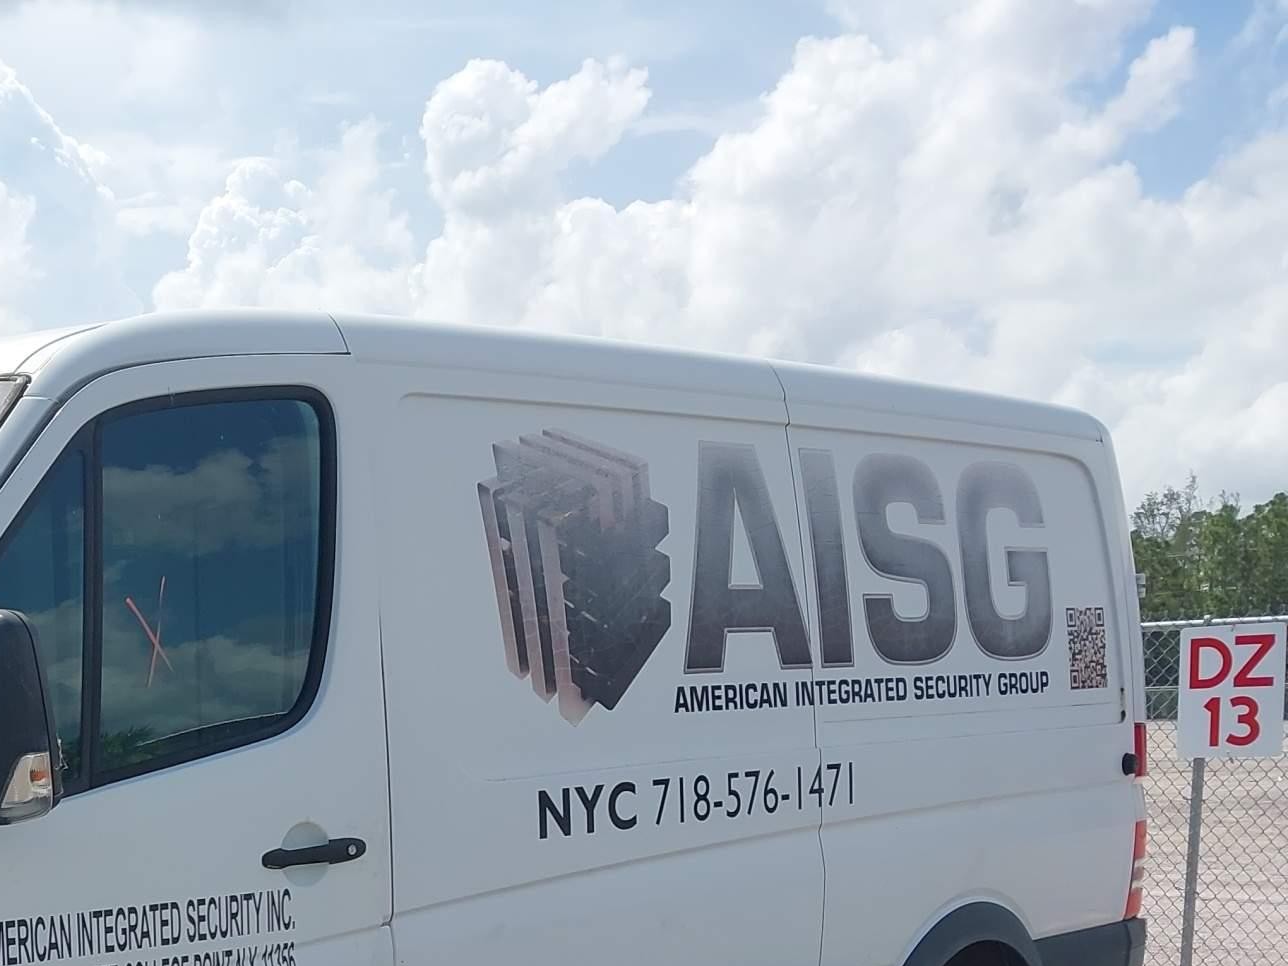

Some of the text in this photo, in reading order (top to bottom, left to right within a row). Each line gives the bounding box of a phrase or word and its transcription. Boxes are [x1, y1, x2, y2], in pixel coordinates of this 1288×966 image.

[684, 440, 1053, 674] AISG
[674, 671, 1050, 713] AMERICAN INTEGRATED SECURITY GROUP
[1189, 633, 1277, 690] DZ
[1203, 695, 1261, 747] 13
[537, 762, 854, 840] NYC 718-576-1471
[76, 902, 181, 957] INTEGRATED
[186, 892, 263, 943] SECURITY
[267, 888, 296, 933] INC.
